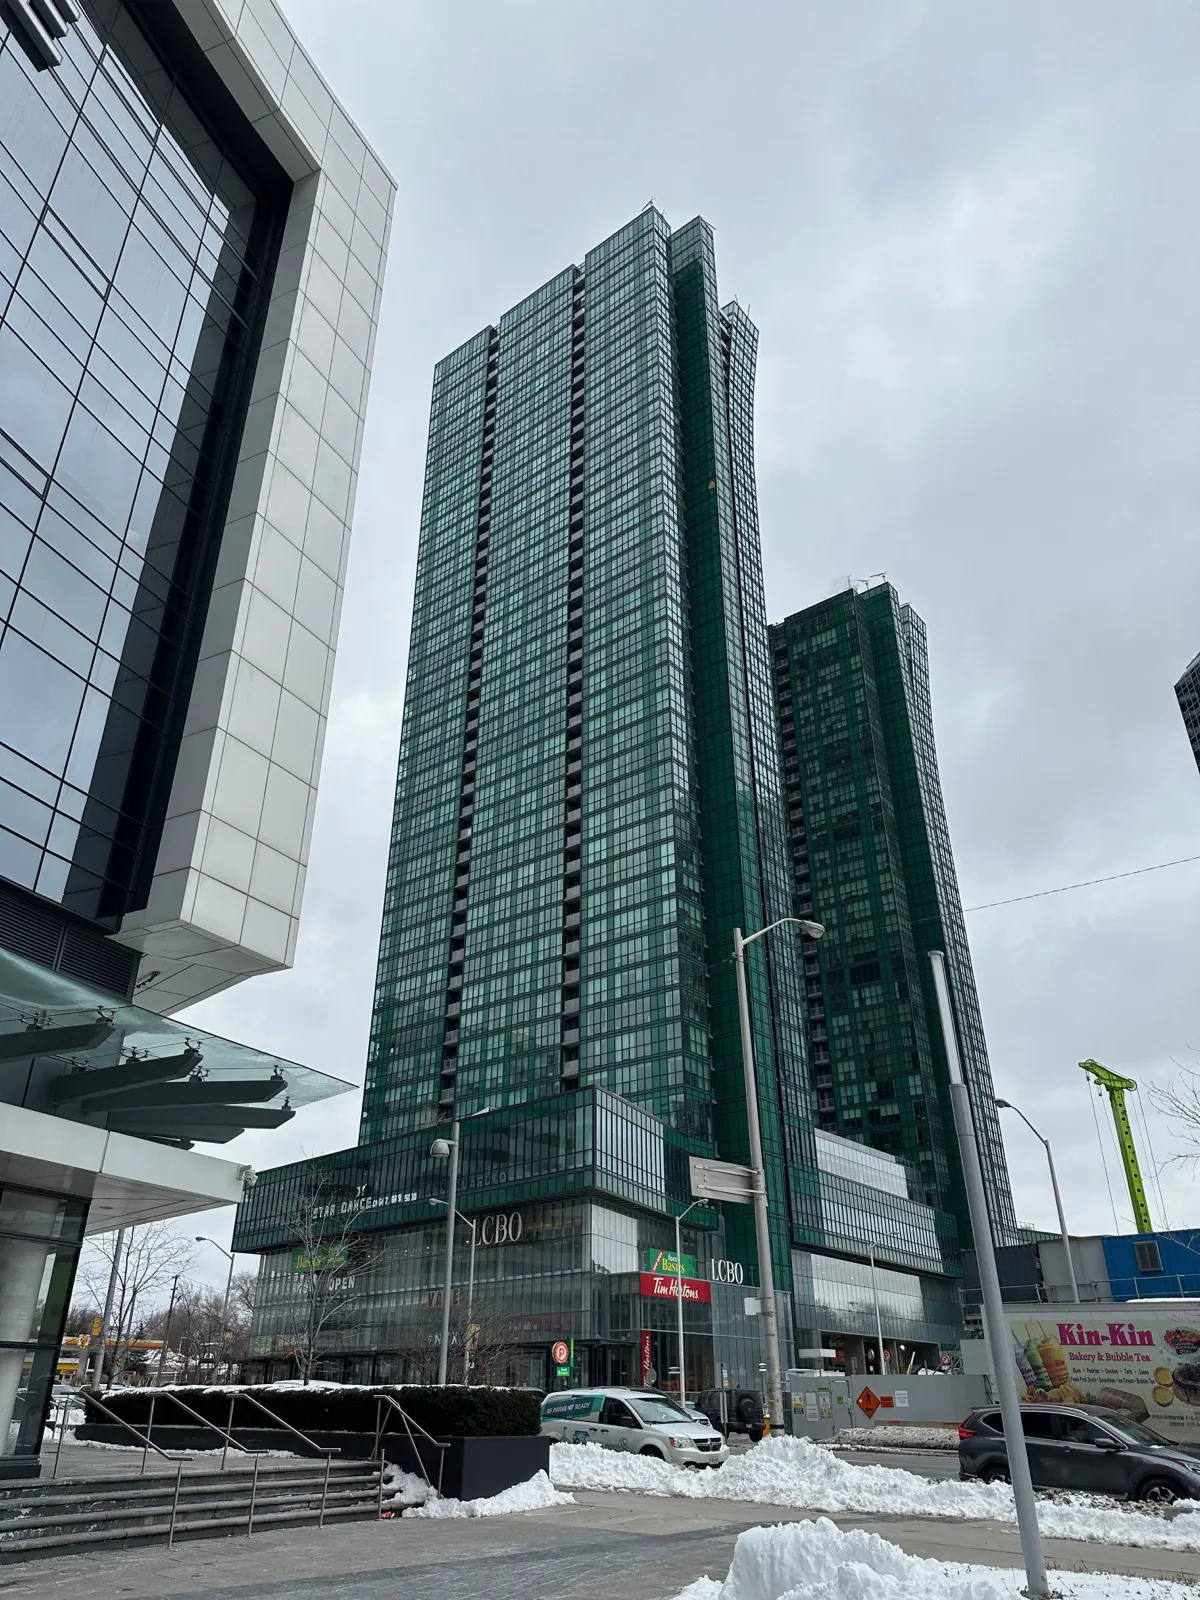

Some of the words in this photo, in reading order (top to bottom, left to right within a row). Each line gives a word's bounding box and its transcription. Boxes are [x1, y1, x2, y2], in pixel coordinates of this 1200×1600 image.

[311, 1204, 336, 1219] STAR
[662, 1258, 686, 1274] Basis
[710, 1258, 744, 1285] LCBO
[328, 1275, 356, 1291] OPEN
[653, 1277, 669, 1296] Tim
[668, 1278, 700, 1299] Hotons
[428, 1289, 459, 1307] VAE
[1056, 1323, 1156, 1346] Kin-Kin
[1069, 1352, 1096, 1363] Bakery
[1097, 1352, 1105, 1361] &
[1106, 1352, 1134, 1362] Bubble
[1134, 1352, 1151, 1362] Tea
[574, 1401, 592, 1410] READY
